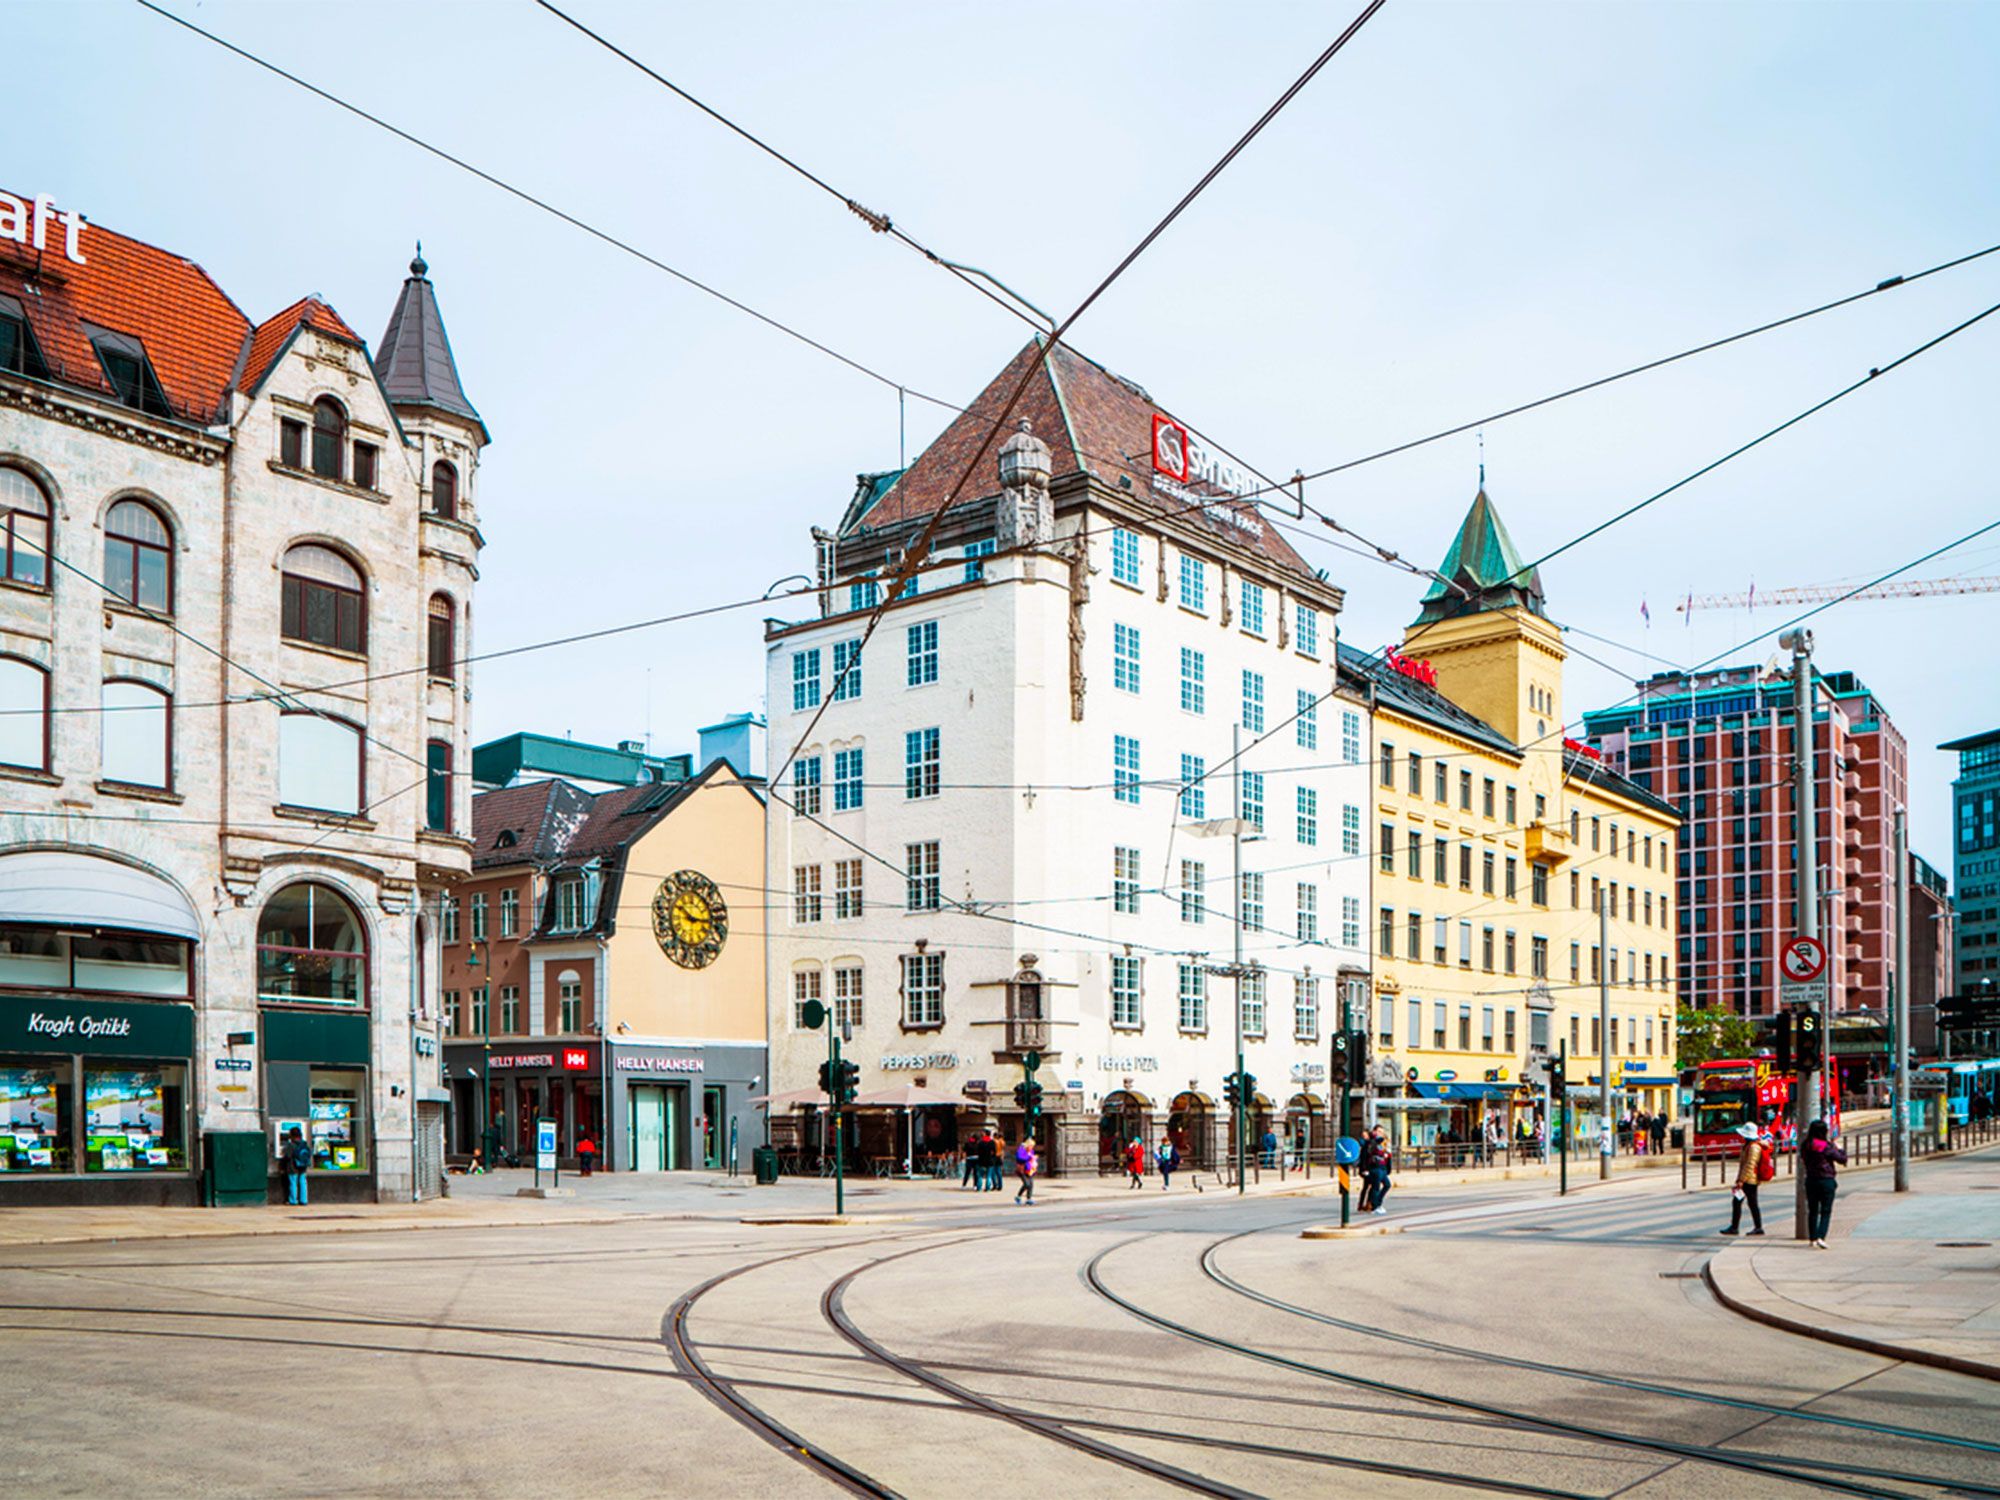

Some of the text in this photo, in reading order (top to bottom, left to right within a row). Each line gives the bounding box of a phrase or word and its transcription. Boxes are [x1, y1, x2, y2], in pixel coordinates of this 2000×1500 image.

[28, 1012, 131, 1039] Krogh Optikk
[1803, 1016, 1814, 1032] S
[1336, 1036, 1346, 1050] S
[515, 1054, 554, 1067] HANSEN
[616, 1056, 704, 1073] HELLY HANSEN
[880, 1052, 960, 1070] PEPPES PIZZA
